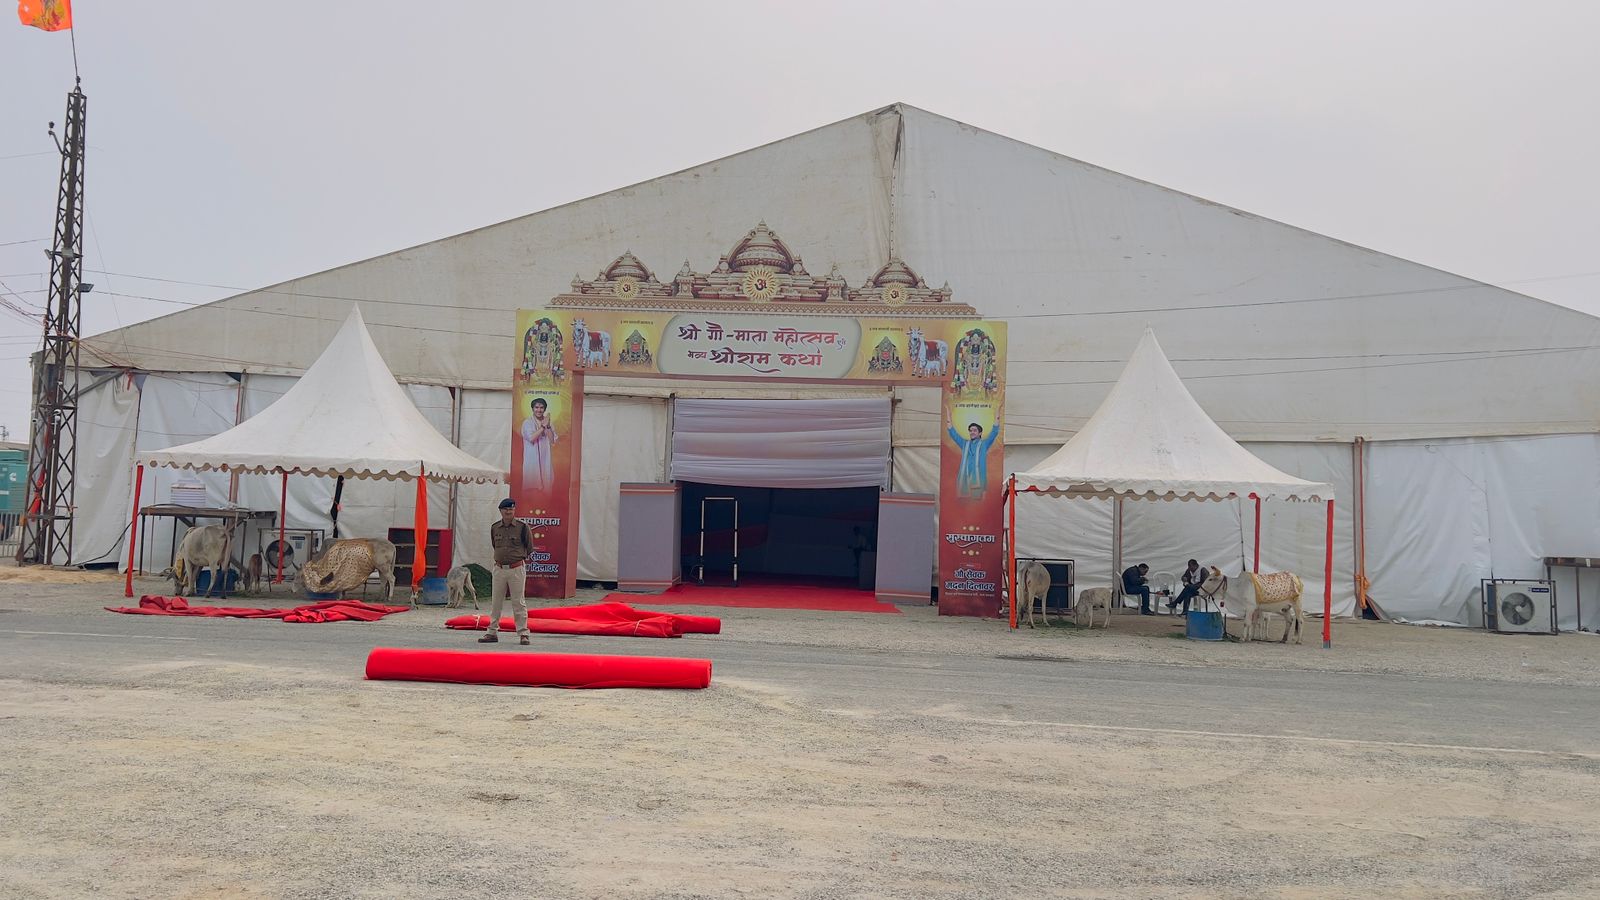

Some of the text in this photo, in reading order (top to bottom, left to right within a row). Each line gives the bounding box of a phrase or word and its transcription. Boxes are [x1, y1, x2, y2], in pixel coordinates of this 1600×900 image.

[678, 323, 702, 341] श्री
[772, 327, 839, 352] महोत्सव
[687, 350, 707, 359] भव्य
[530, 551, 551, 561] सेवक
[531, 561, 559, 573] दिलावर
[966, 580, 995, 592] दिलावर
